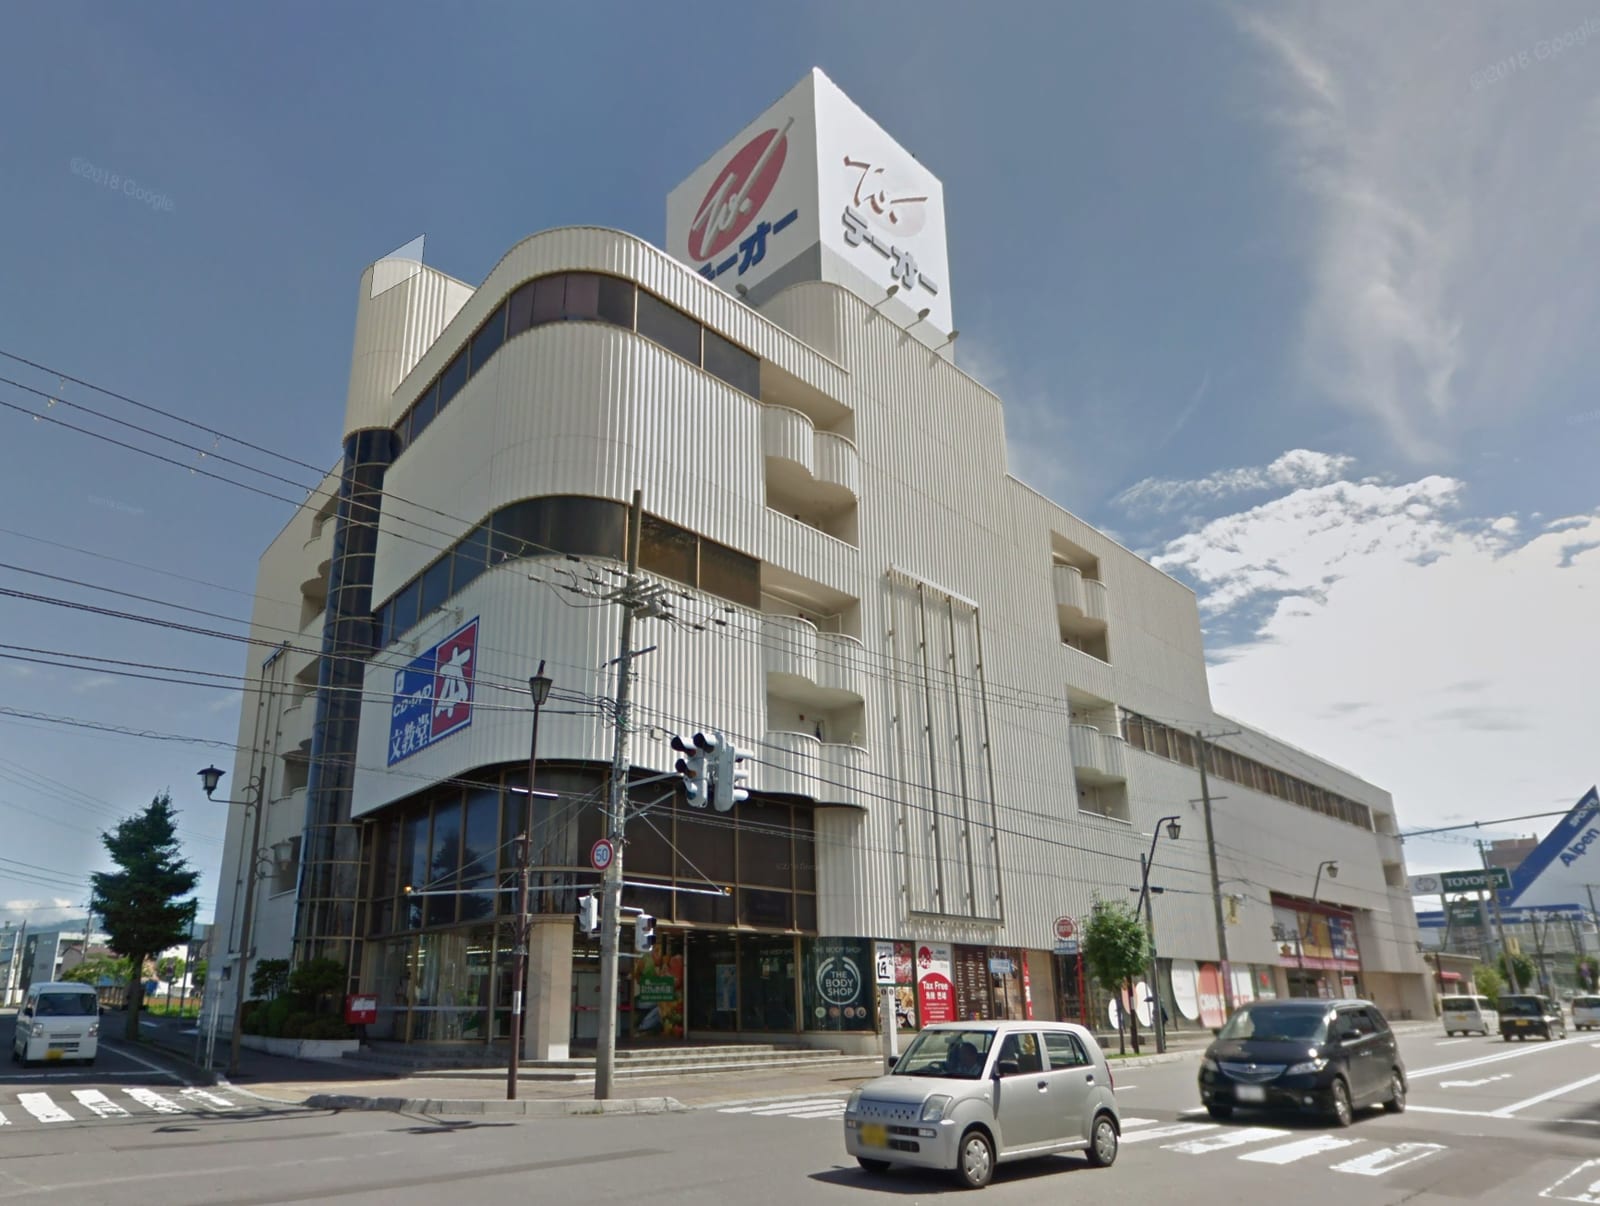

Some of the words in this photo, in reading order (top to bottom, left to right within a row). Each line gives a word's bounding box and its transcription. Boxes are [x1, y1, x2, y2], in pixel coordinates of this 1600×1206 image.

[841, 205, 938, 296] テーオー
[1560, 826, 1600, 867] Alpen
[596, 848, 608, 862] 50
[831, 971, 848, 979] THE
[825, 978, 854, 988] BODY
[922, 981, 934, 990] Tax
[934, 981, 949, 991] Free
[827, 987, 853, 997] SHOP
